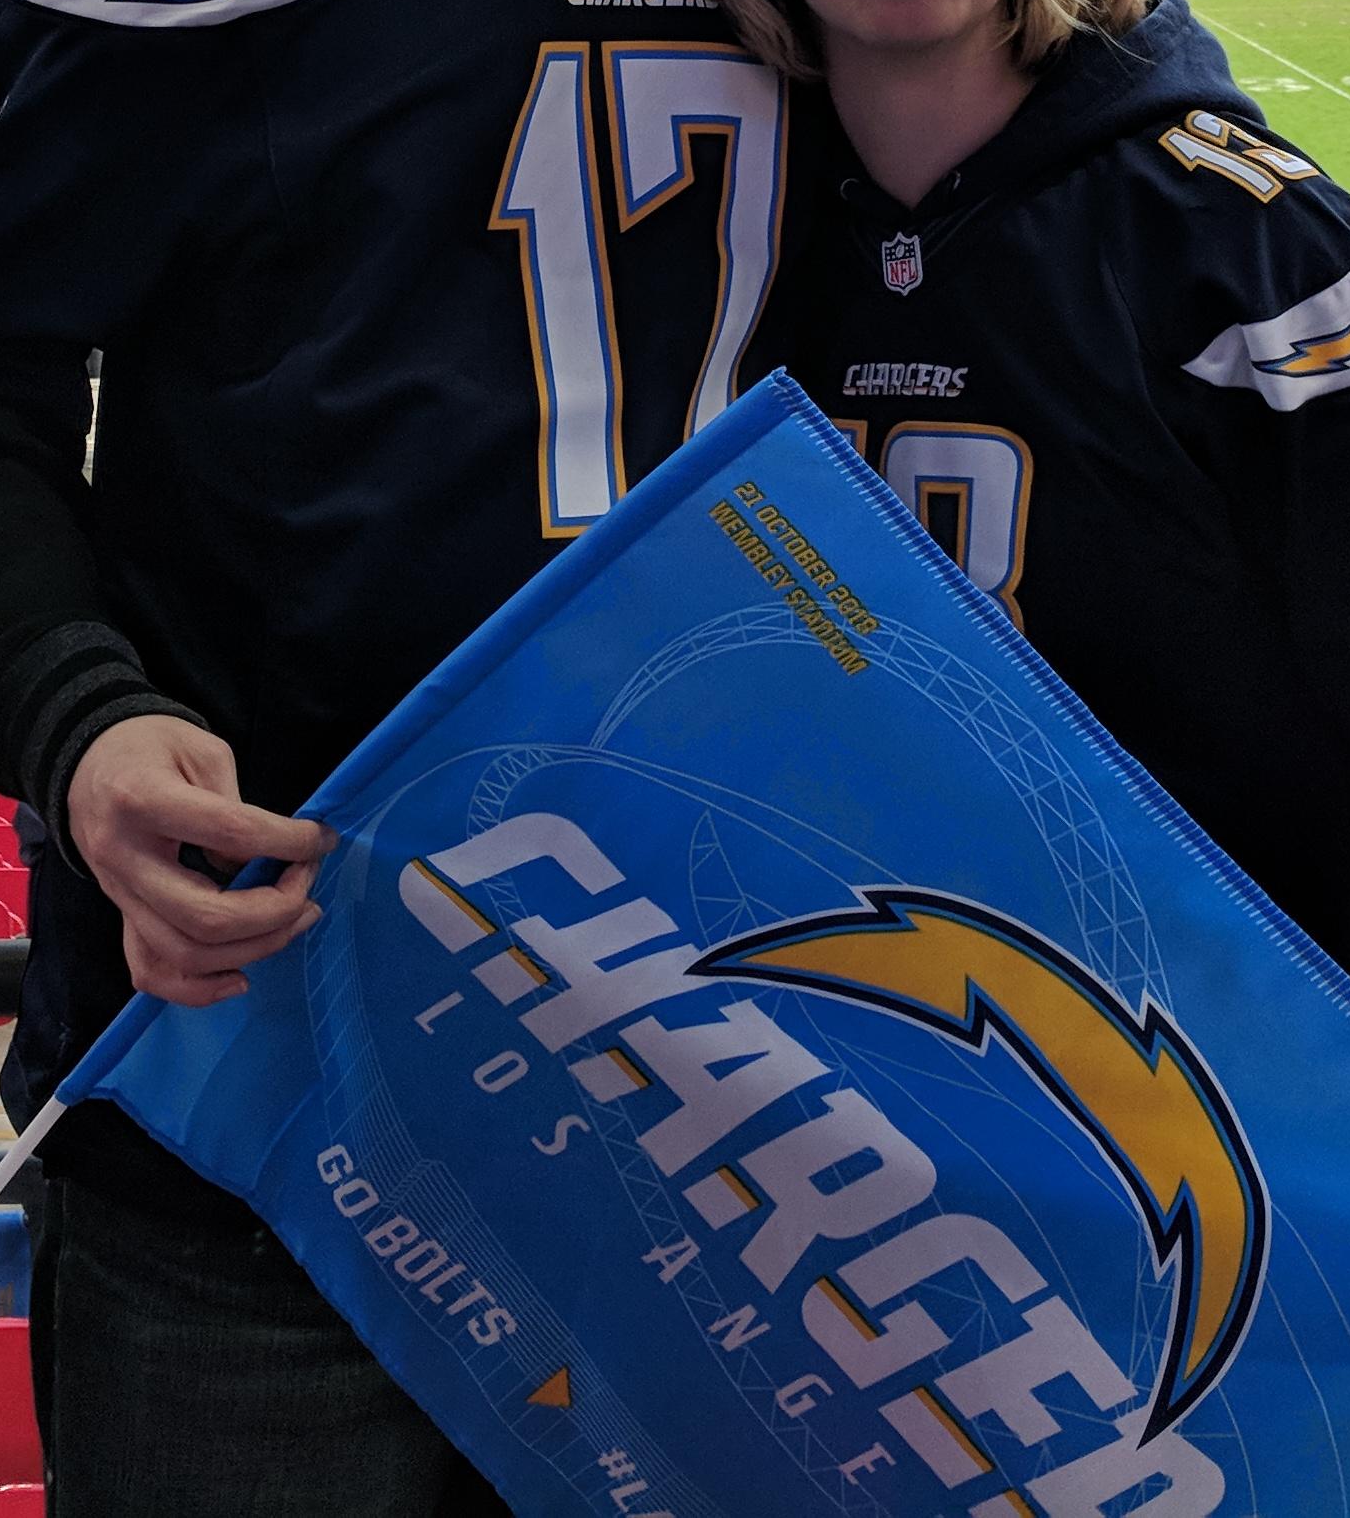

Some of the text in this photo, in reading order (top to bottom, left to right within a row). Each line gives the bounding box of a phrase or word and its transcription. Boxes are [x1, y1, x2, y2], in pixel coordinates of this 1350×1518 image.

[487, 41, 791, 539] 17
[889, 259, 918, 283] NFL
[842, 362, 970, 398] CHARGERS
[708, 499, 870, 676] WEMBLEY STADIUM
[733, 481, 881, 635] 21 OCTOBER 2018
[316, 1143, 518, 1347] GO BOLTS
[398, 811, 1227, 1518] CHARGER
[414, 990, 898, 1487] LOS ANGE
